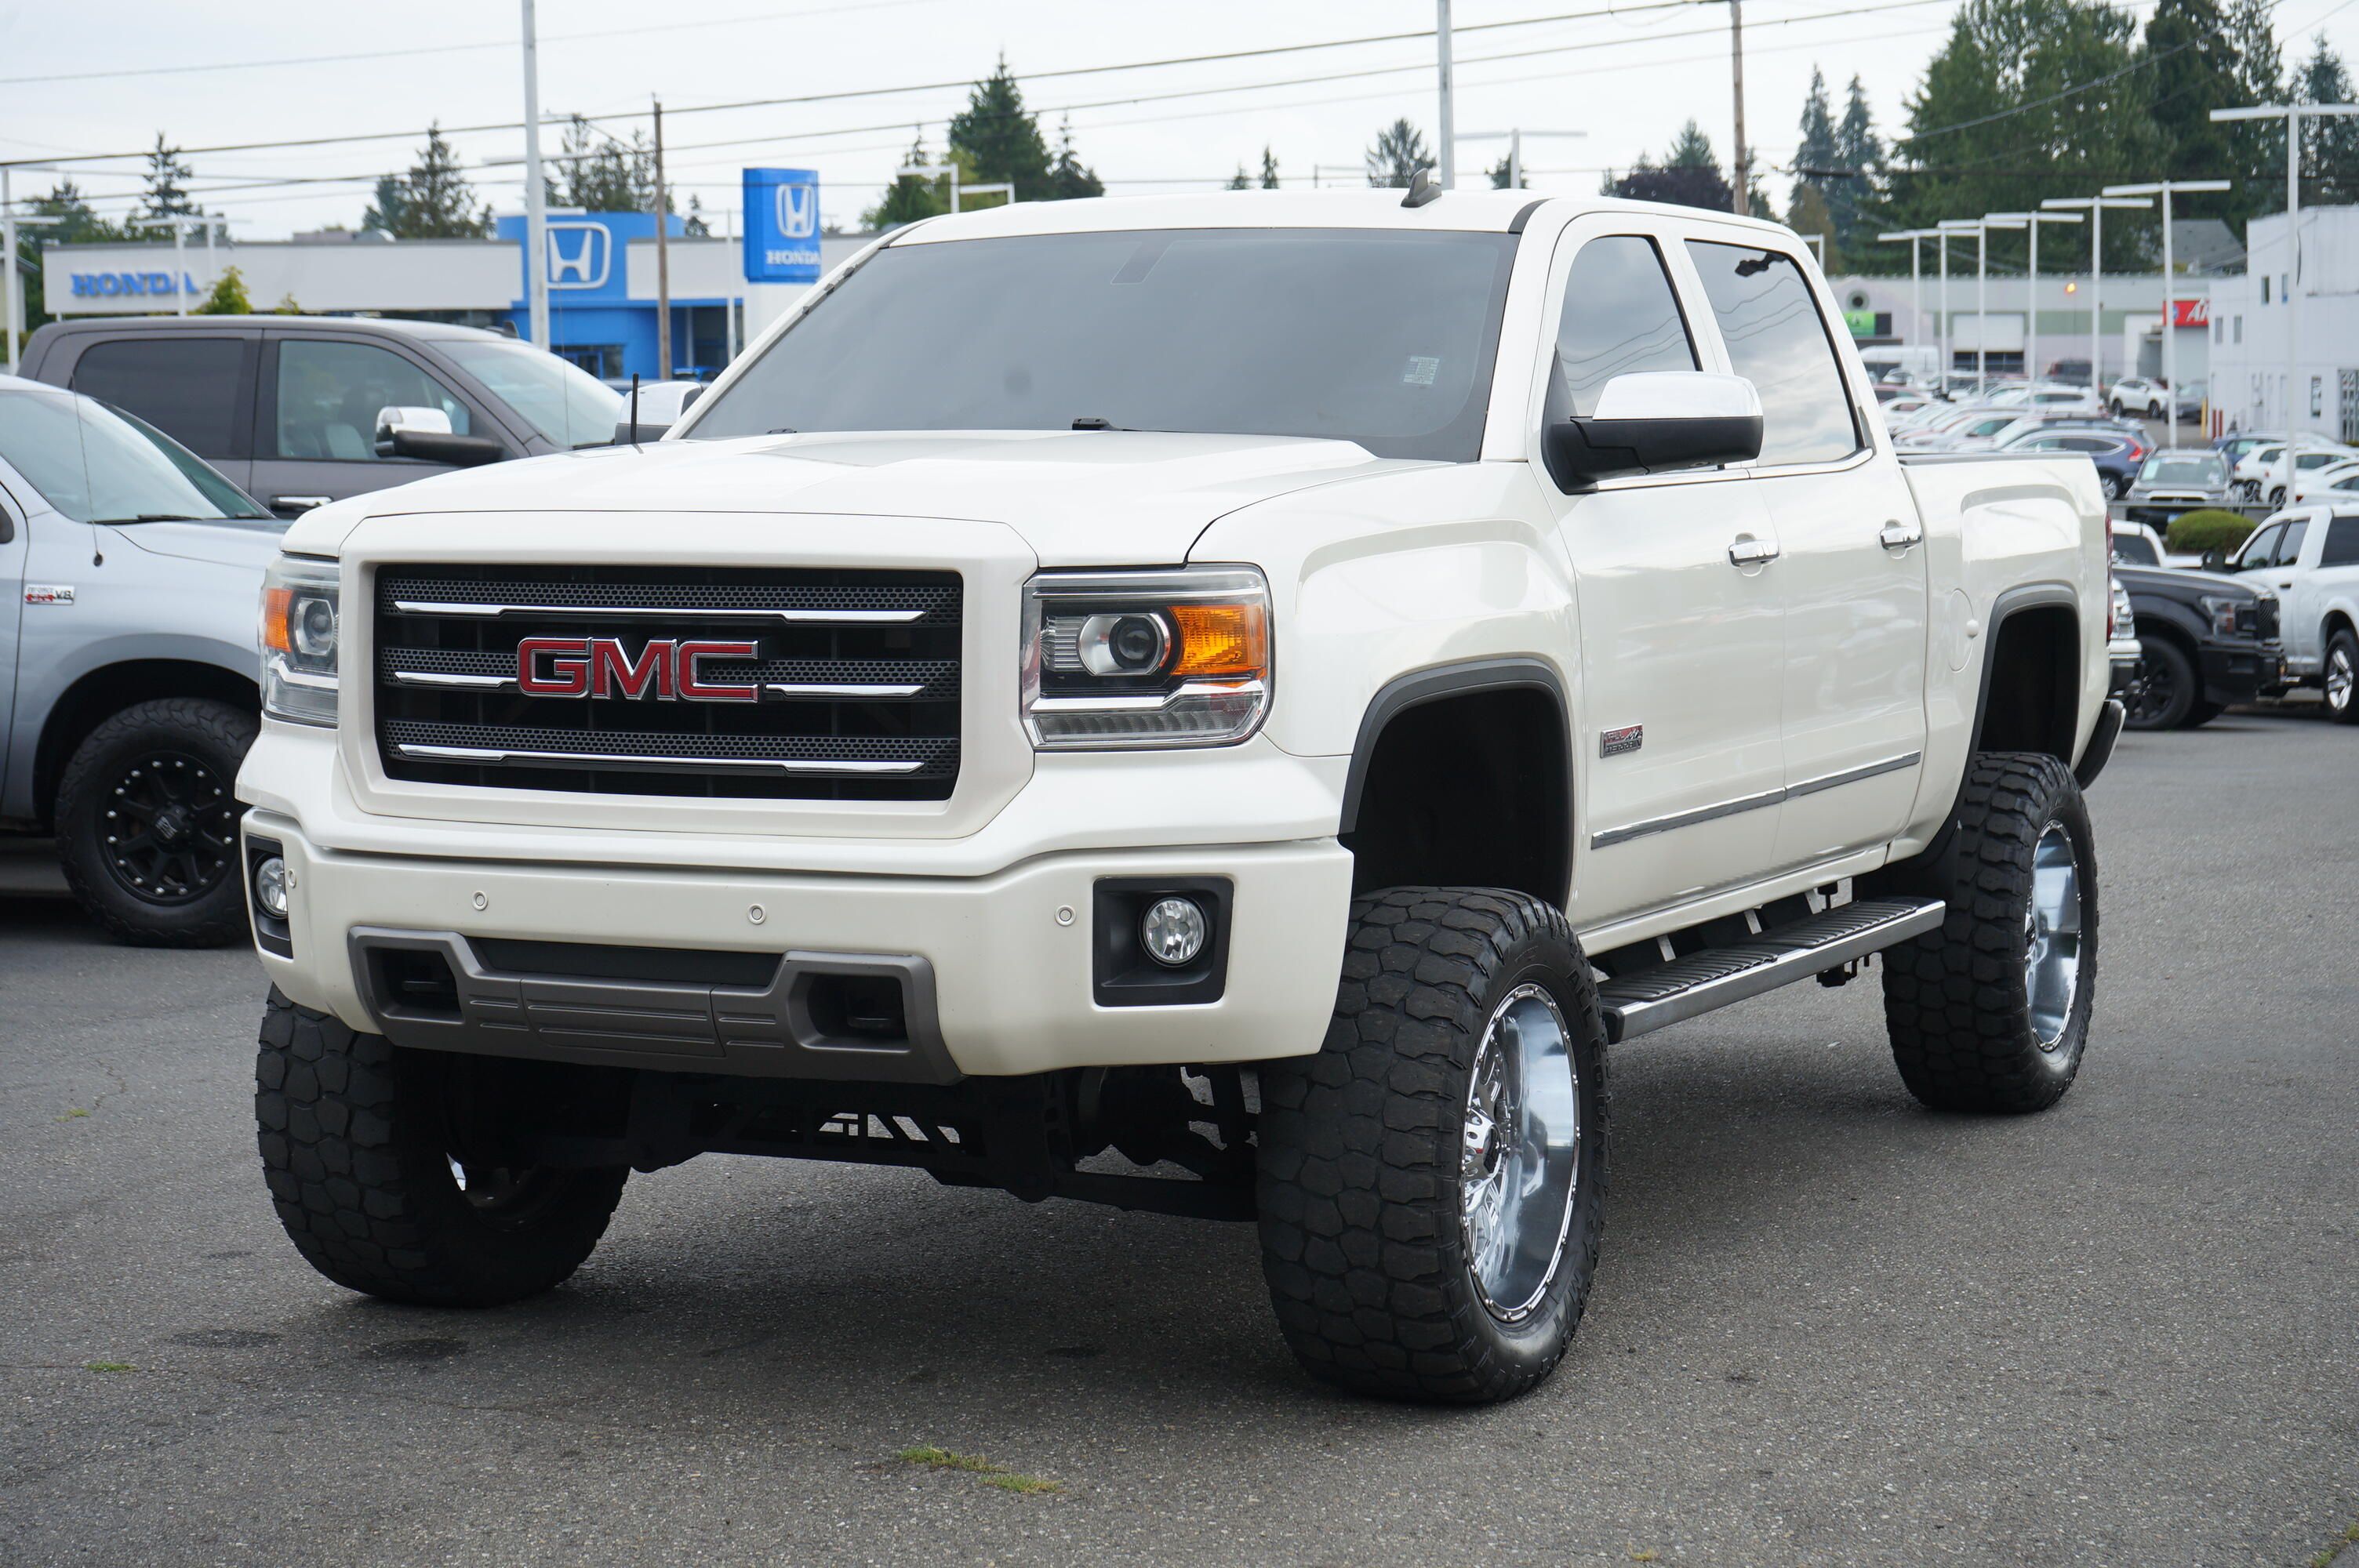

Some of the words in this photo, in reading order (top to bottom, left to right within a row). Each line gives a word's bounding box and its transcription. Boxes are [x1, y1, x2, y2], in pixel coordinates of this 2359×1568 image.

[767, 250, 821, 265] HONDA
[71, 273, 201, 295] HONDA
[518, 637, 759, 703] GMC
[1607, 731, 1624, 742] ALL
[1605, 739, 1642, 753] TERRAIN
